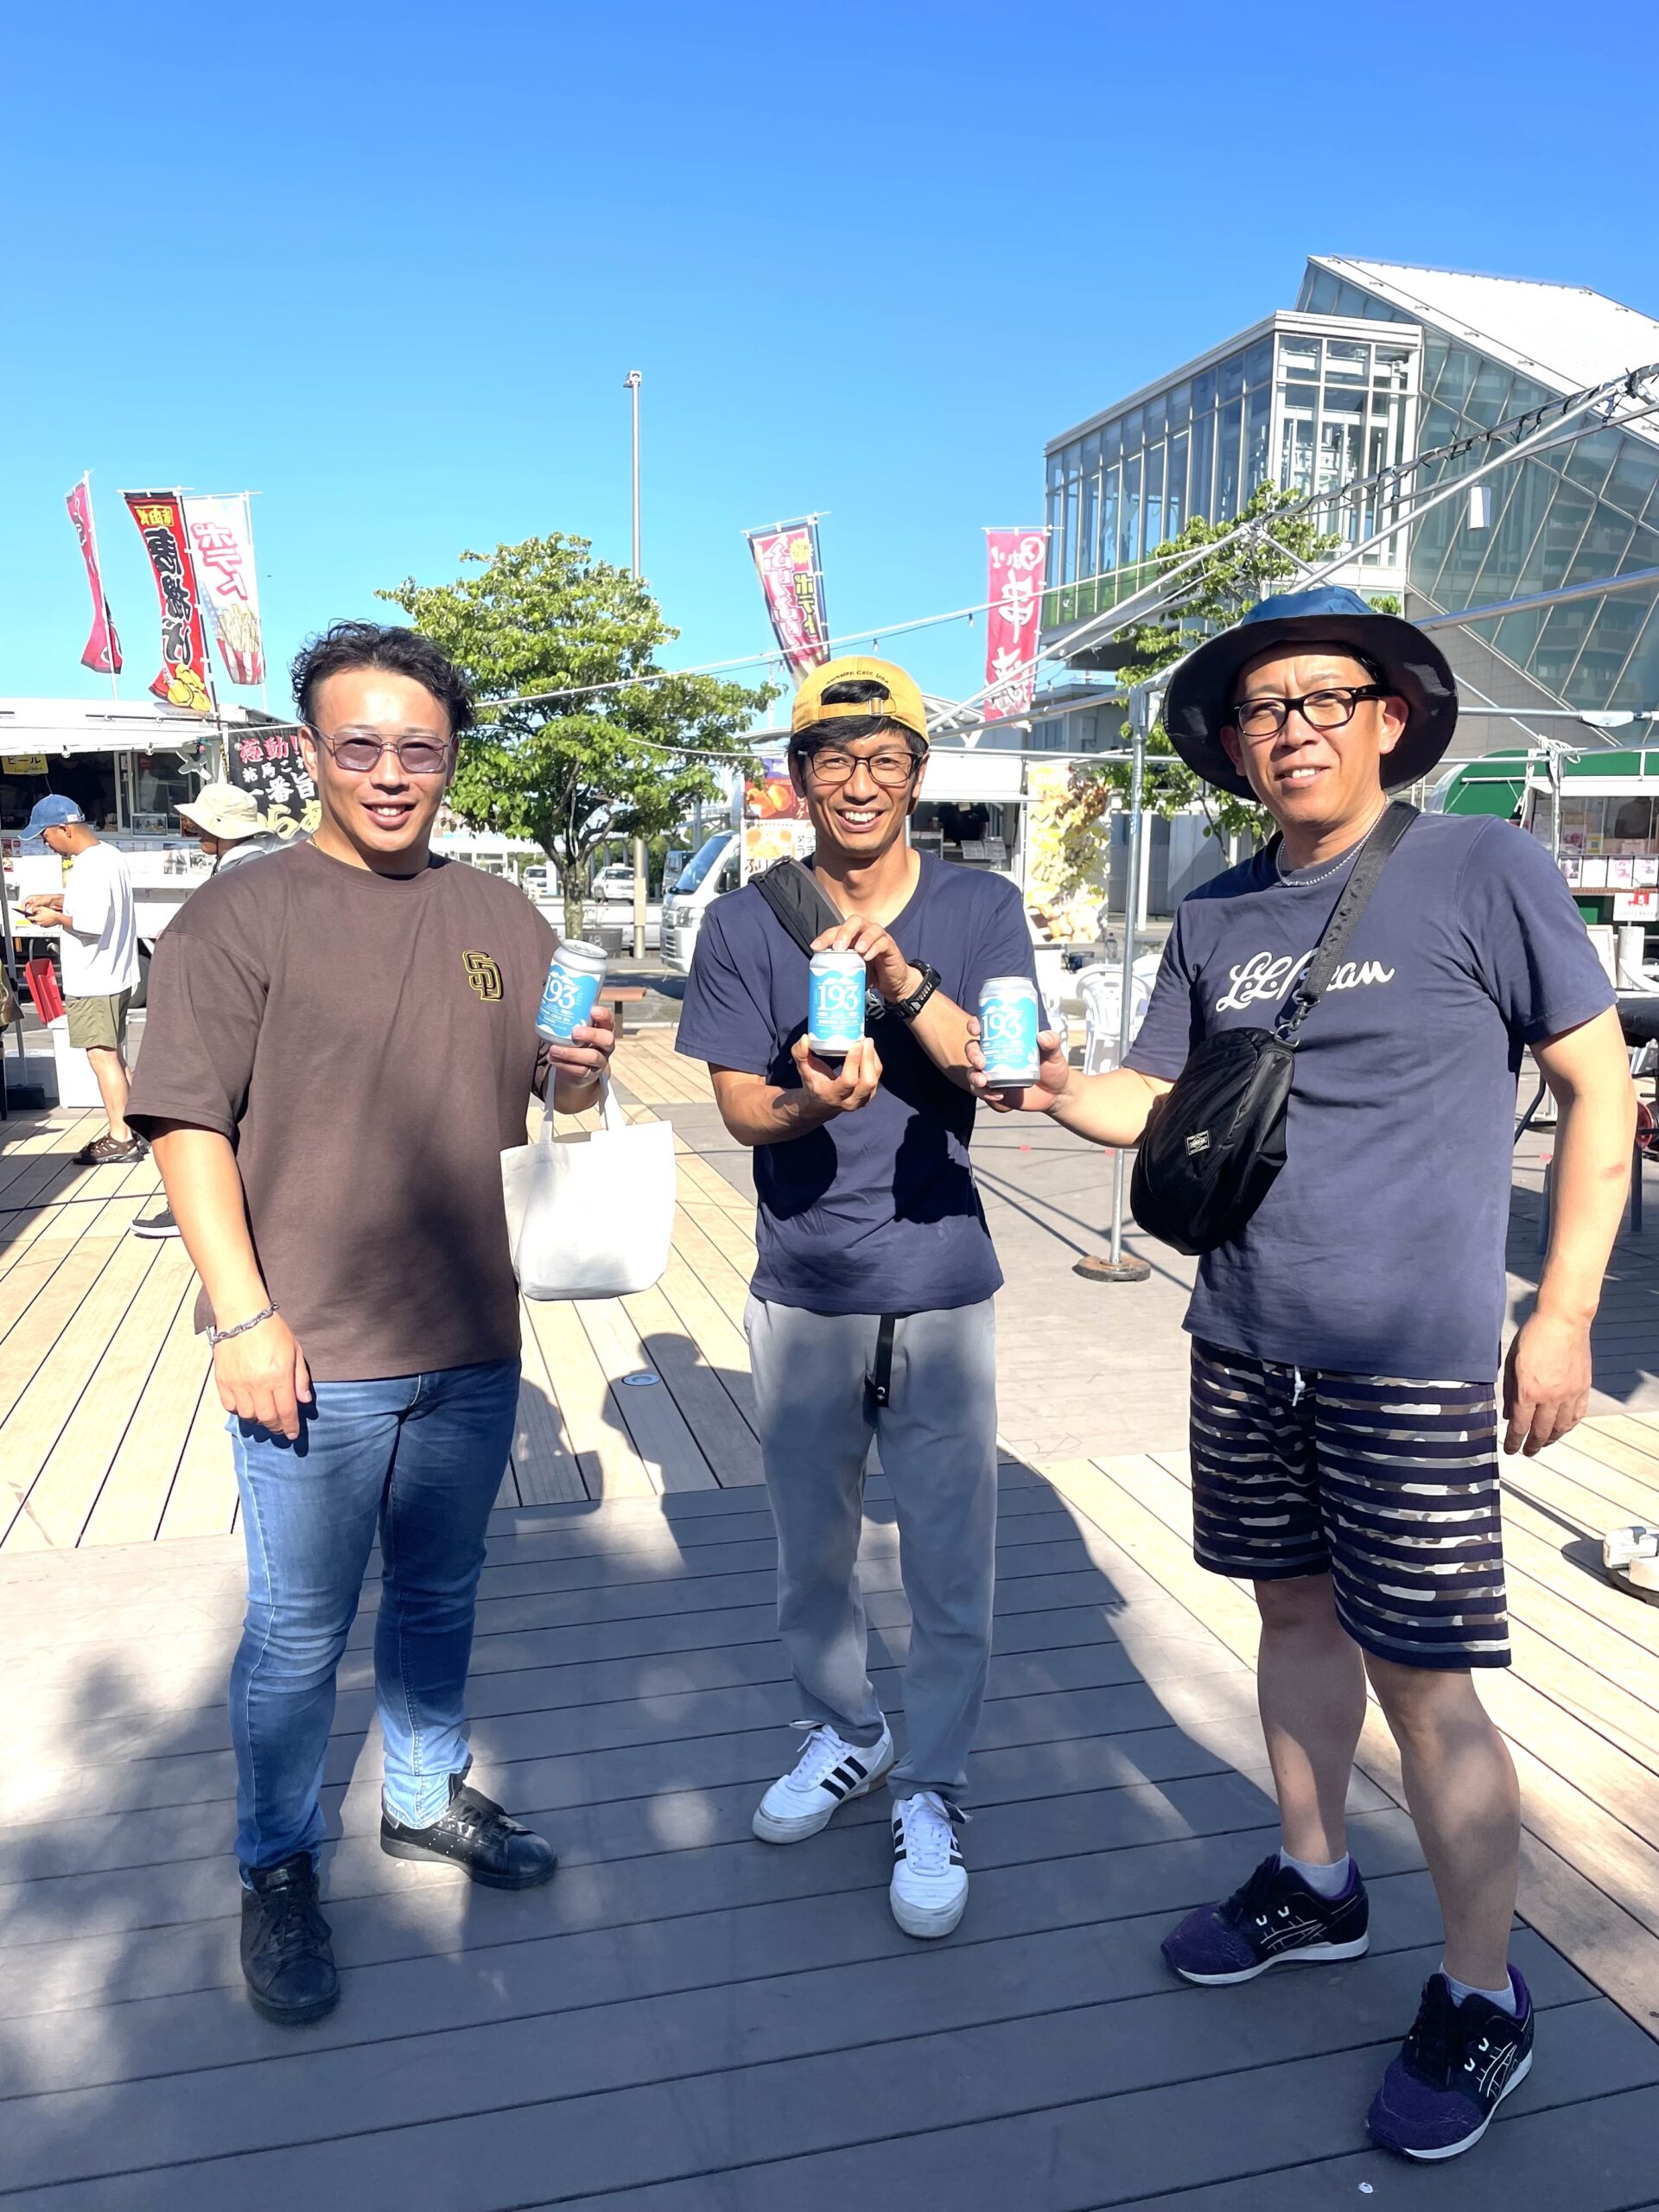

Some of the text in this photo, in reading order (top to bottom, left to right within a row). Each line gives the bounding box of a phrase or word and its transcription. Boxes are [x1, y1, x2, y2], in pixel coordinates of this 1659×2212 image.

[543, 975, 582, 1009] 193
[817, 985, 859, 1011] 193
[982, 1012, 1023, 1040] 193
